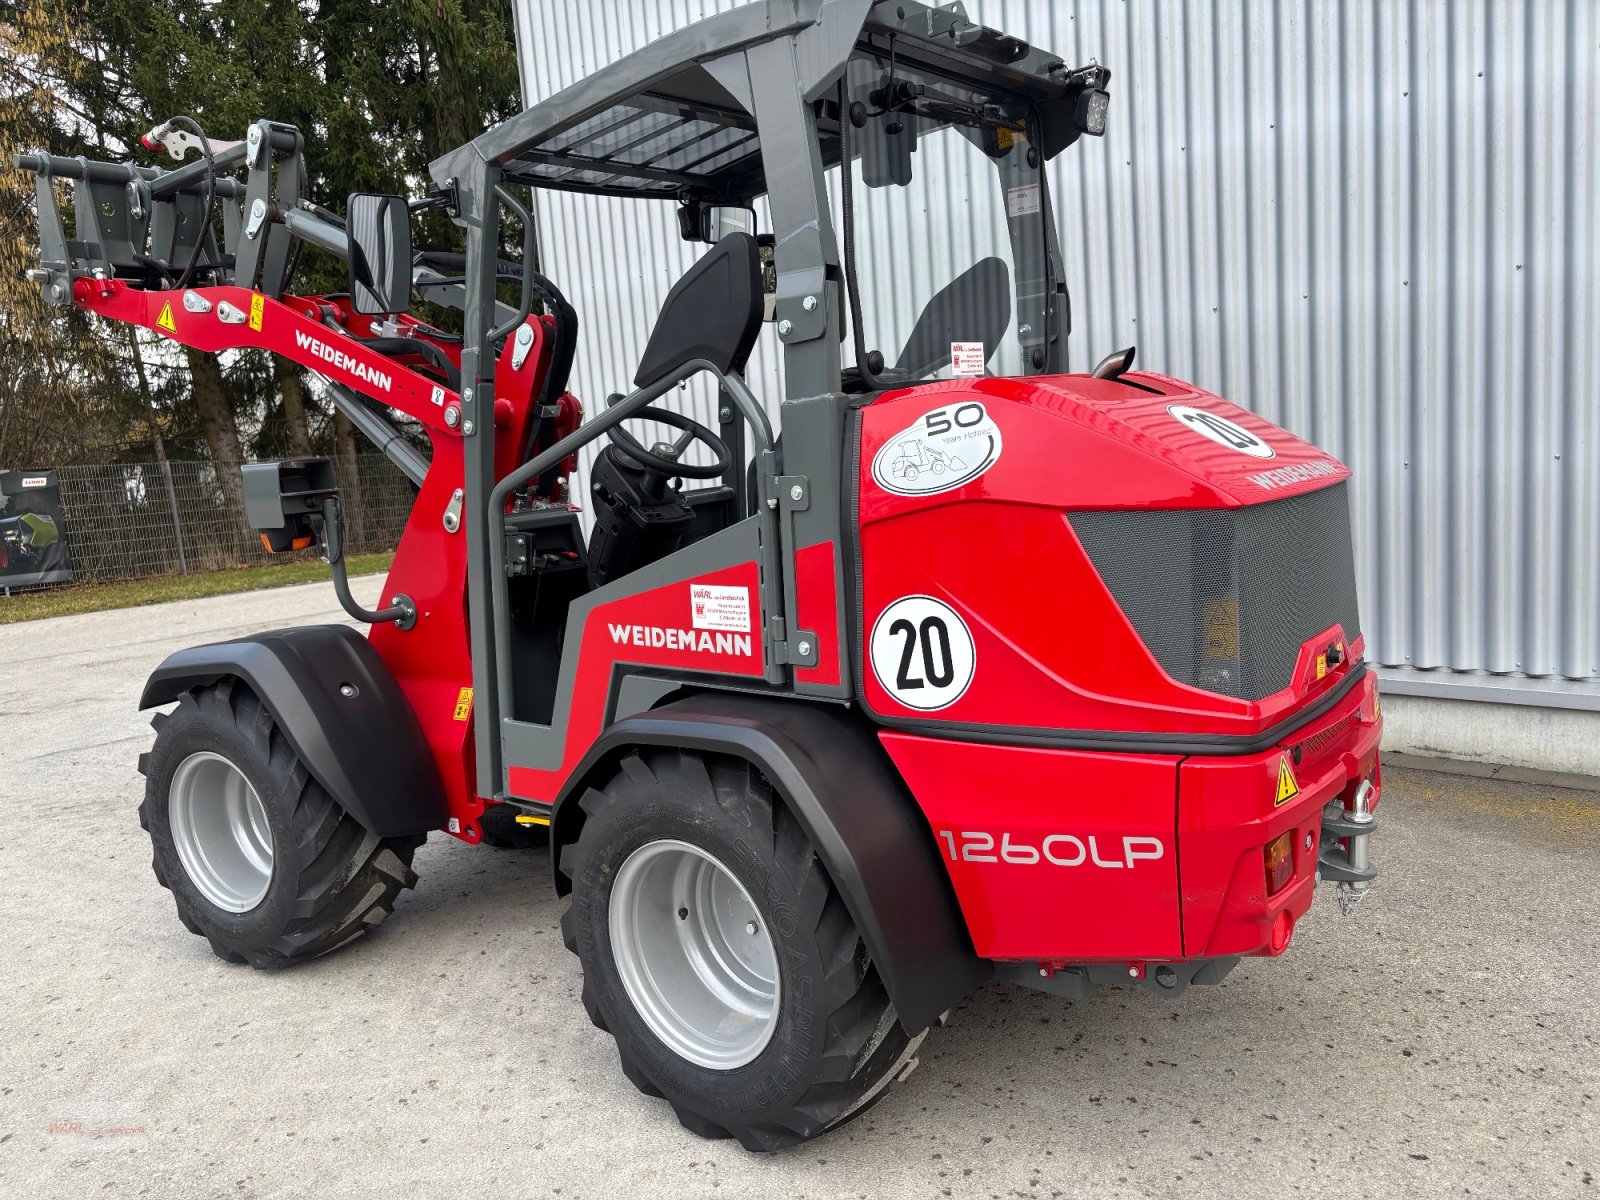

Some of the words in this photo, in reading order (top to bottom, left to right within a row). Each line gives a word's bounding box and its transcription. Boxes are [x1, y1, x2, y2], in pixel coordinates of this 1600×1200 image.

[295, 329, 392, 392] WEIDEMANN
[925, 403, 984, 437] 50
[1182, 413, 1259, 449] 20
[1246, 460, 1339, 491] WEIDEMANN
[607, 623, 752, 657] WEIDEMANN
[889, 615, 954, 690] 20
[939, 830, 1164, 869] 1260LP
